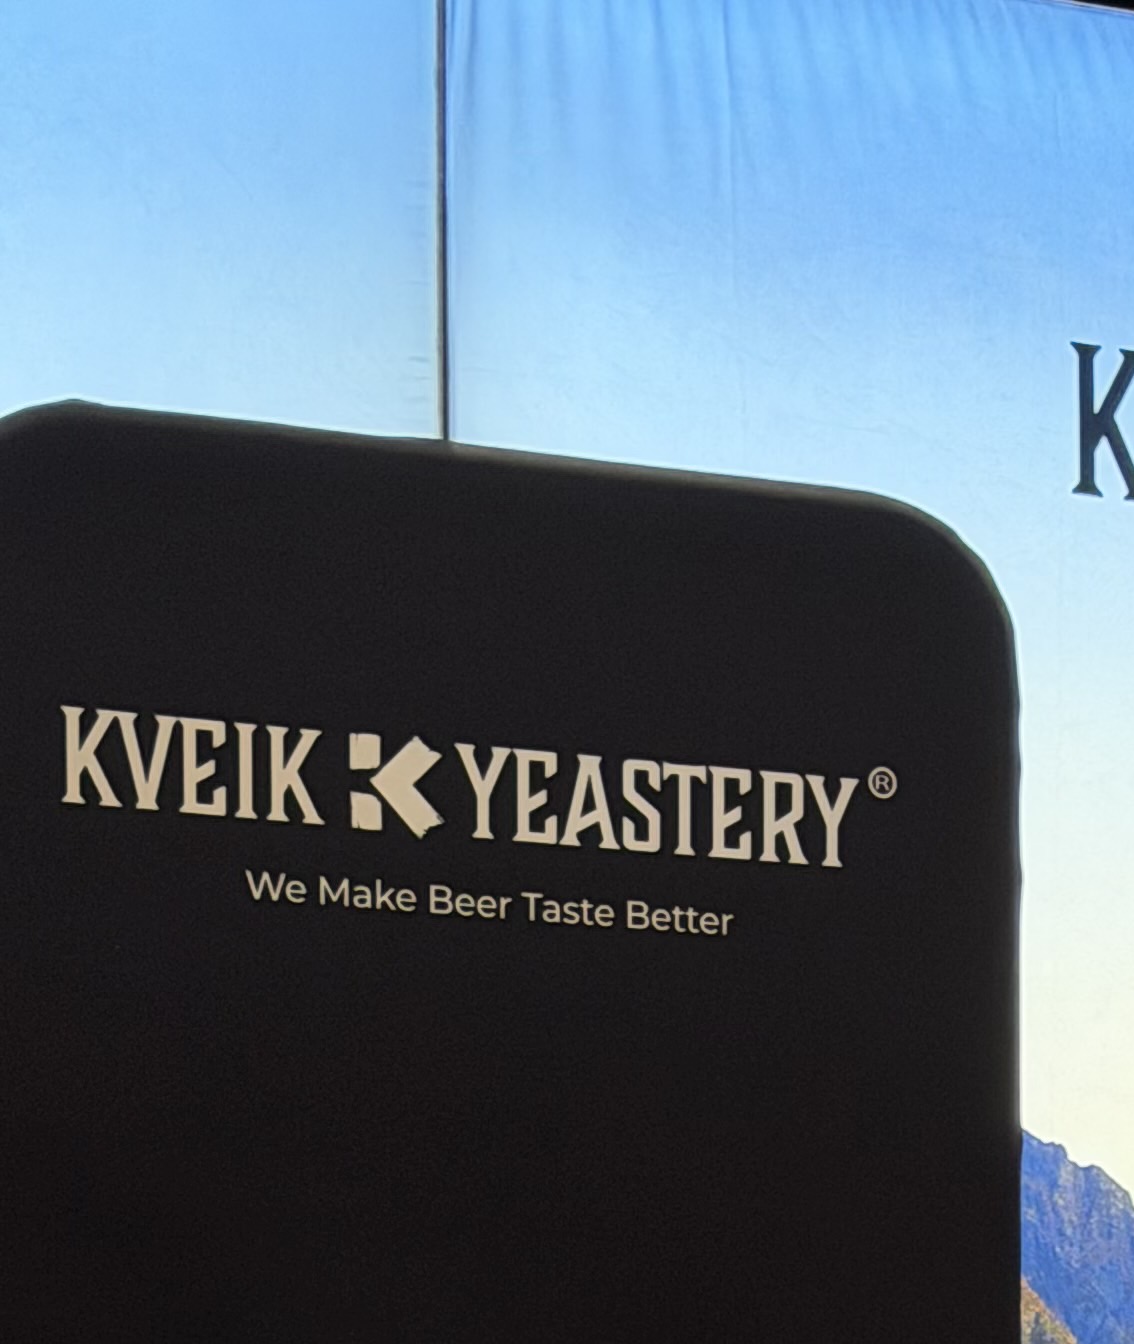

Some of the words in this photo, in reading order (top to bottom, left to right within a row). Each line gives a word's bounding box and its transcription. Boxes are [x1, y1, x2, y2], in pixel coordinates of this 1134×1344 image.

[60, 705, 323, 826] KVEIK
[244, 869, 307, 905] We
[317, 876, 417, 913] Make
[428, 883, 512, 920] Beer
[521, 891, 617, 927] Taste
[625, 899, 735, 937] Better
